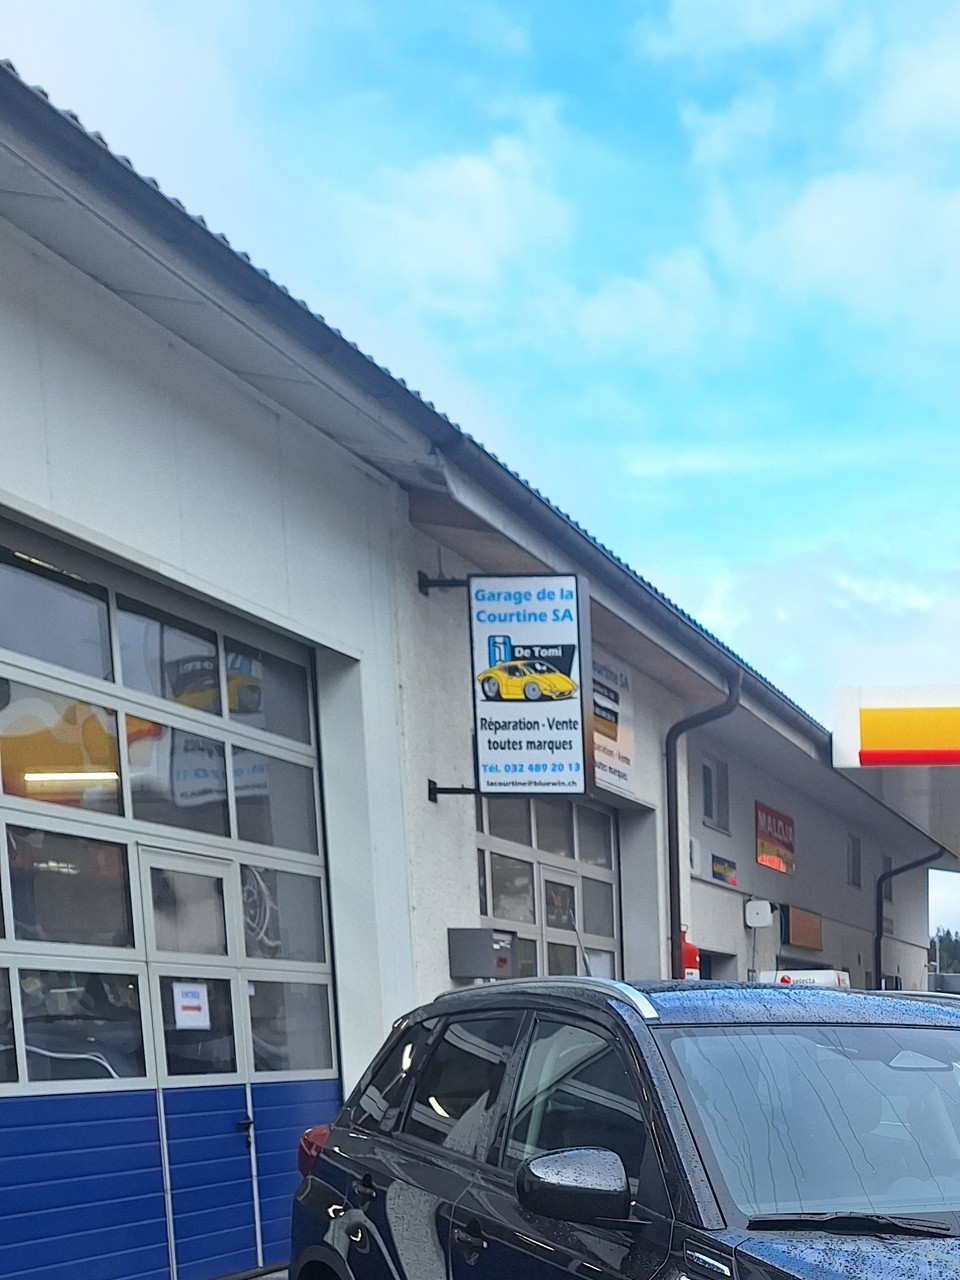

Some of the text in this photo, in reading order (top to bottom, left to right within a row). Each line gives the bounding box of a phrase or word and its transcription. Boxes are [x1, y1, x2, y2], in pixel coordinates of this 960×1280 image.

[475, 588, 574, 605] Garage de la
[476, 608, 573, 622] Courtine SA
[514, 646, 562, 656] De Tomi
[480, 717, 540, 735] Réparation
[547, 717, 579, 730] Vente
[488, 738, 573, 755] toutes marques
[504, 764, 525, 773] 032
[528, 764, 548, 773] 489
[551, 763, 565, 772] 20
[569, 762, 580, 772] 13
